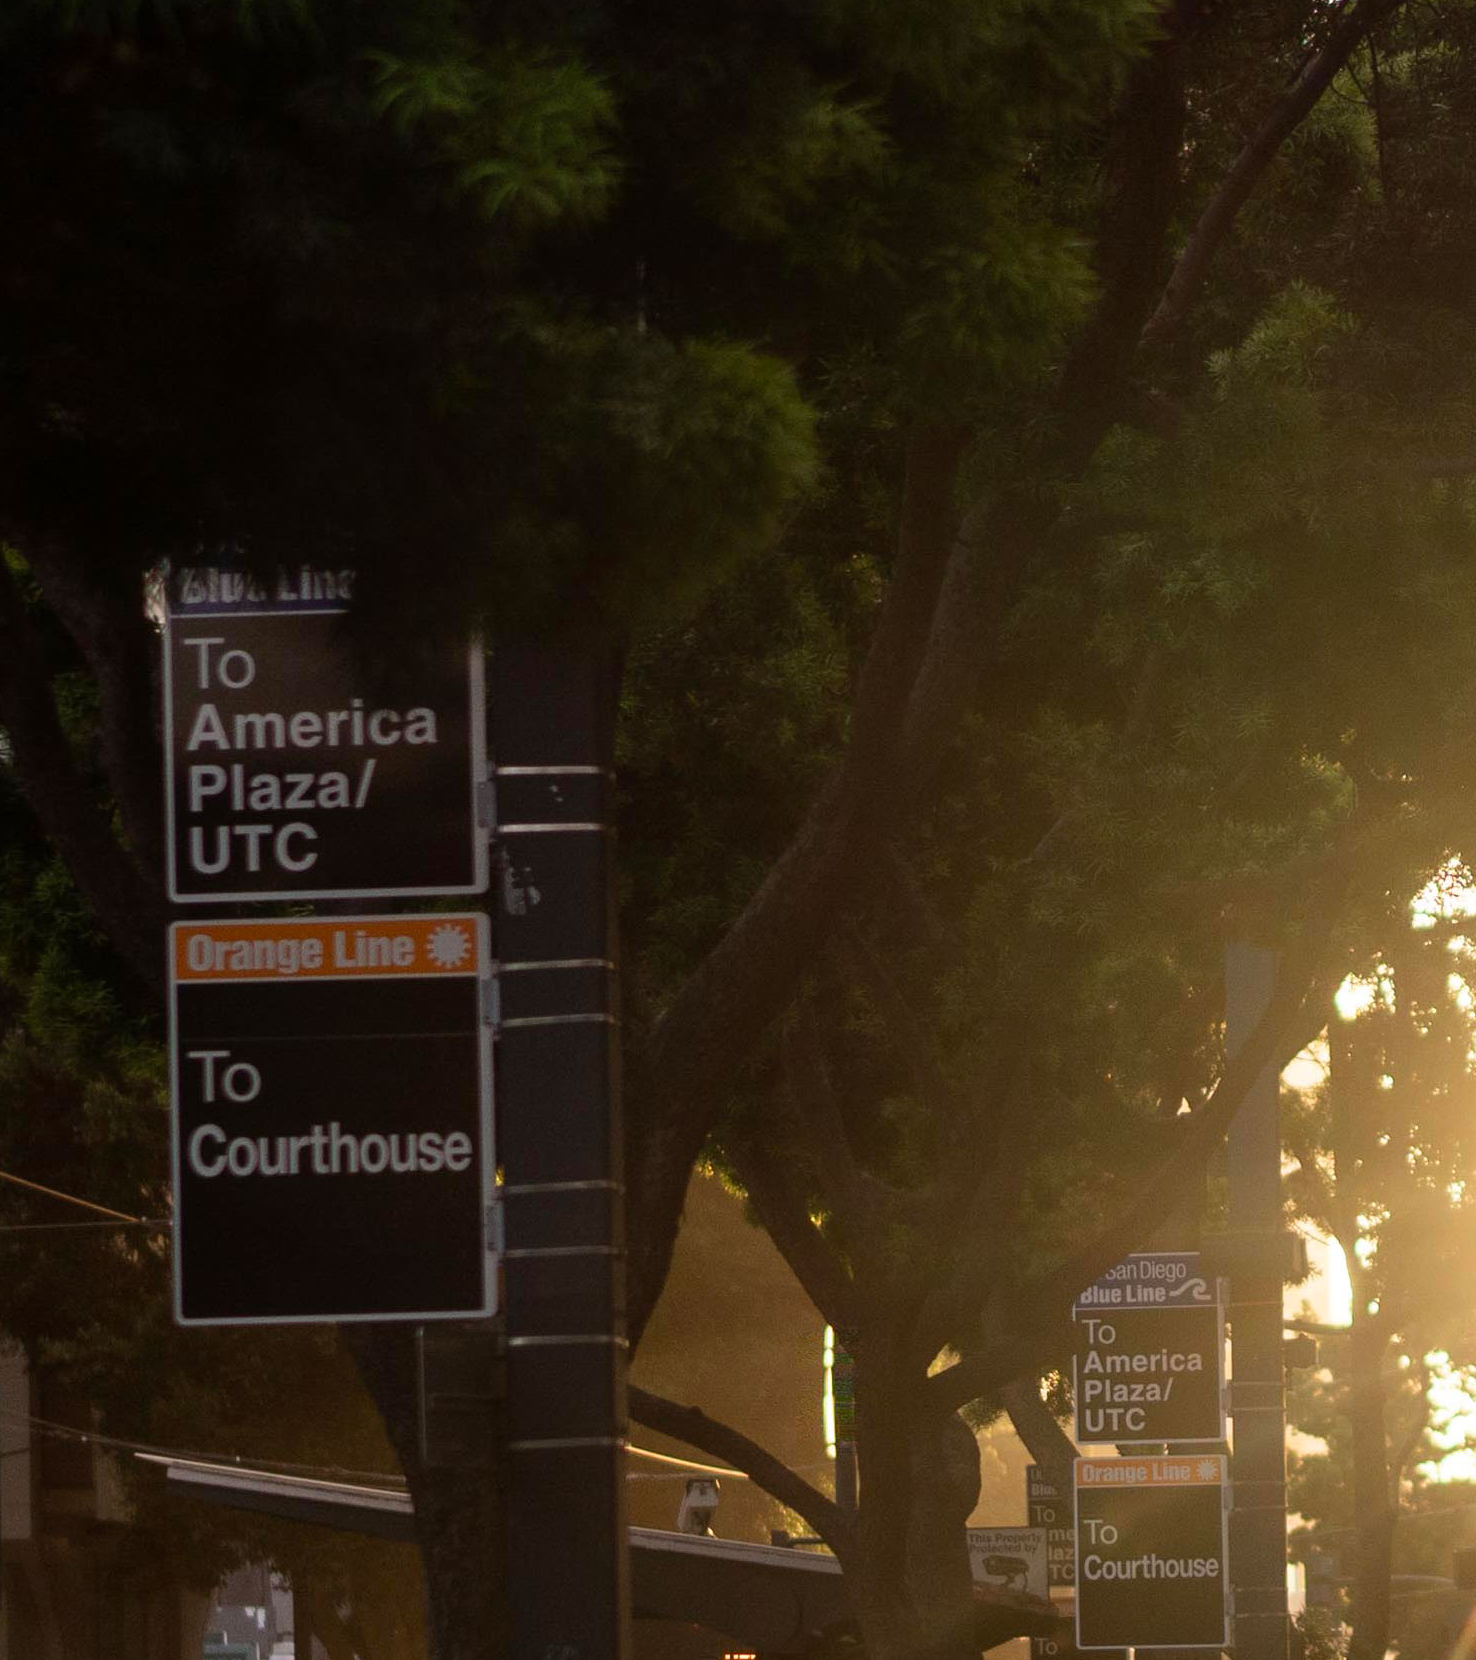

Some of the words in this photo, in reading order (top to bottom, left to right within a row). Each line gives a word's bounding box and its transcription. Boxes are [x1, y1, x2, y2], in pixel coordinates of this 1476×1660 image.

[184, 637, 255, 689] To
[188, 699, 438, 750] America
[188, 759, 376, 812] Plaza/
[188, 822, 319, 875] UTC
[186, 933, 324, 974] Orange
[332, 930, 416, 967] Line
[186, 1050, 262, 1102] To
[188, 1121, 473, 1177] Courthouse
[1140, 1261, 1186, 1283] Diego
[1081, 1286, 1122, 1304] Blue
[1126, 1284, 1166, 1303] Line
[1082, 1319, 1116, 1344] To
[1084, 1349, 1203, 1374] America
[1085, 1378, 1173, 1403] Plaza/
[1085, 1408, 1146, 1432] UTC
[1082, 1464, 1147, 1484] Orange
[1152, 1463, 1191, 1481] Line
[1033, 1505, 1055, 1522] To
[996, 1533, 1041, 1545] Property
[1083, 1519, 1118, 1544] To
[1084, 1554, 1219, 1580] Courthouse
[1034, 1637, 1058, 1655] To
